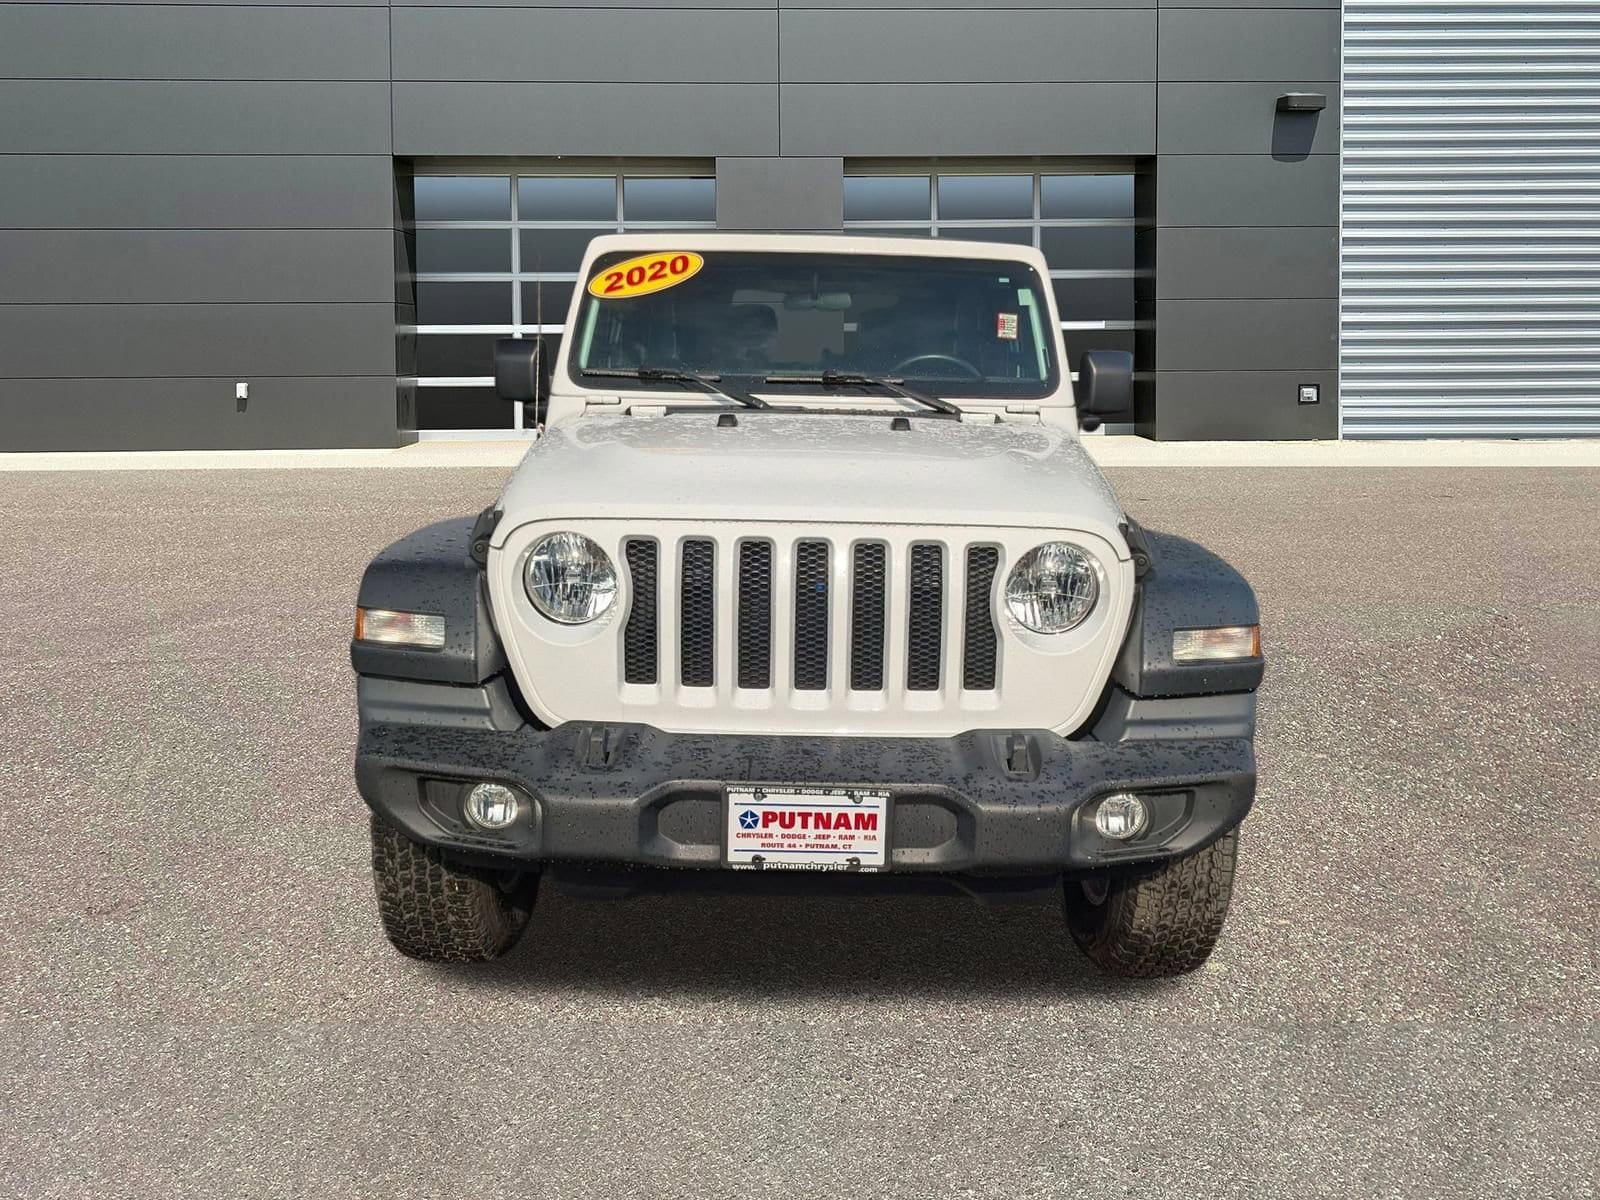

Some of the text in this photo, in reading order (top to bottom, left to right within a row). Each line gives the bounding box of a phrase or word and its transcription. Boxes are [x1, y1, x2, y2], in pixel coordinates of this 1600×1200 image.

[604, 255, 689, 294] 2020
[762, 811, 878, 831] PUTNAM
[735, 832, 774, 840] CHRYSLER
